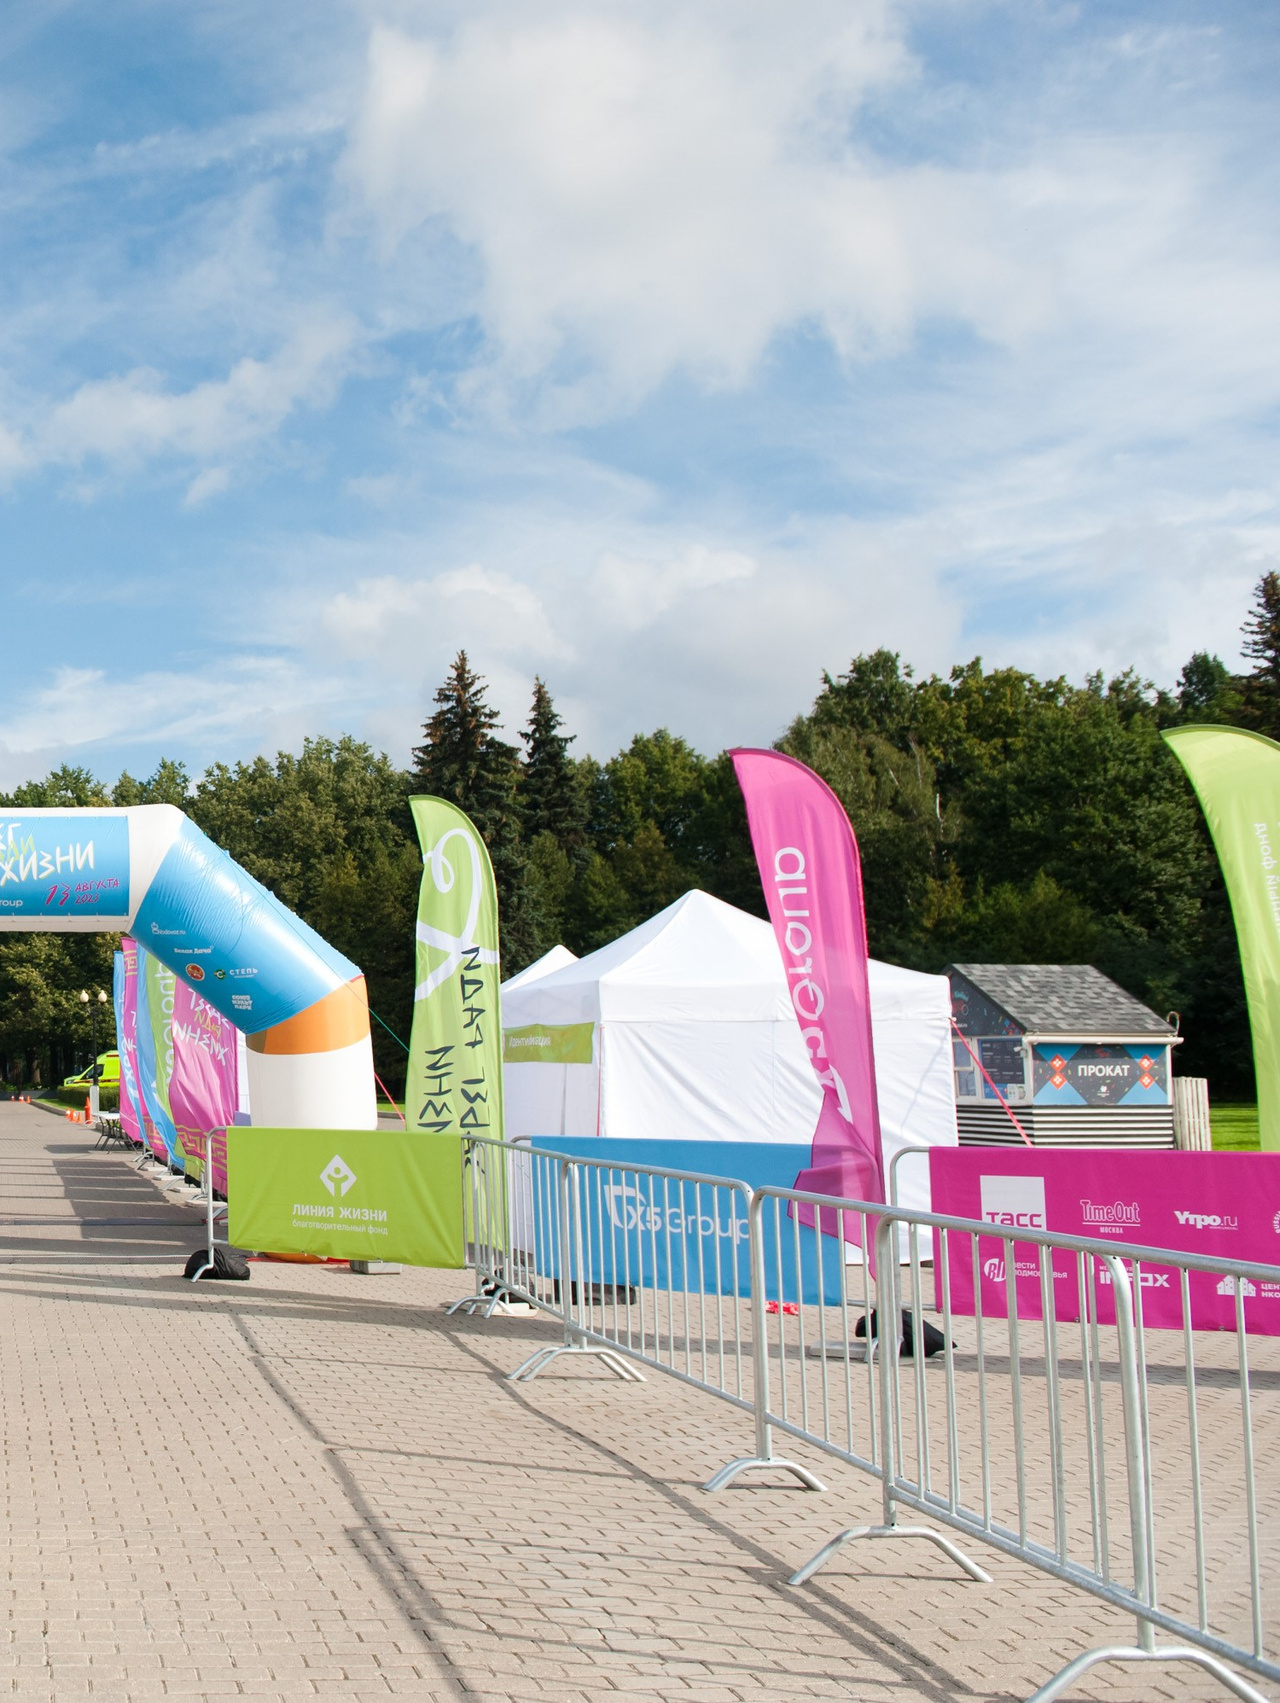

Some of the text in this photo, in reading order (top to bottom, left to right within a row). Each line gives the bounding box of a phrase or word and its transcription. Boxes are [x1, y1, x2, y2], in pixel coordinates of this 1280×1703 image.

[45, 878, 119, 906] 13 АВГУСТА
[230, 967, 258, 976] СТЕПЬ
[1078, 1064, 1130, 1077] ПРОКАТ
[292, 1203, 387, 1222] ЛИНИЯ ЖИЗНИ
[292, 1219, 388, 1235] благотворительный фонд
[1100, 1226, 1124, 1234] МОСКВА
[1014, 1270, 1068, 1279] ОДМОСВЬЯ
